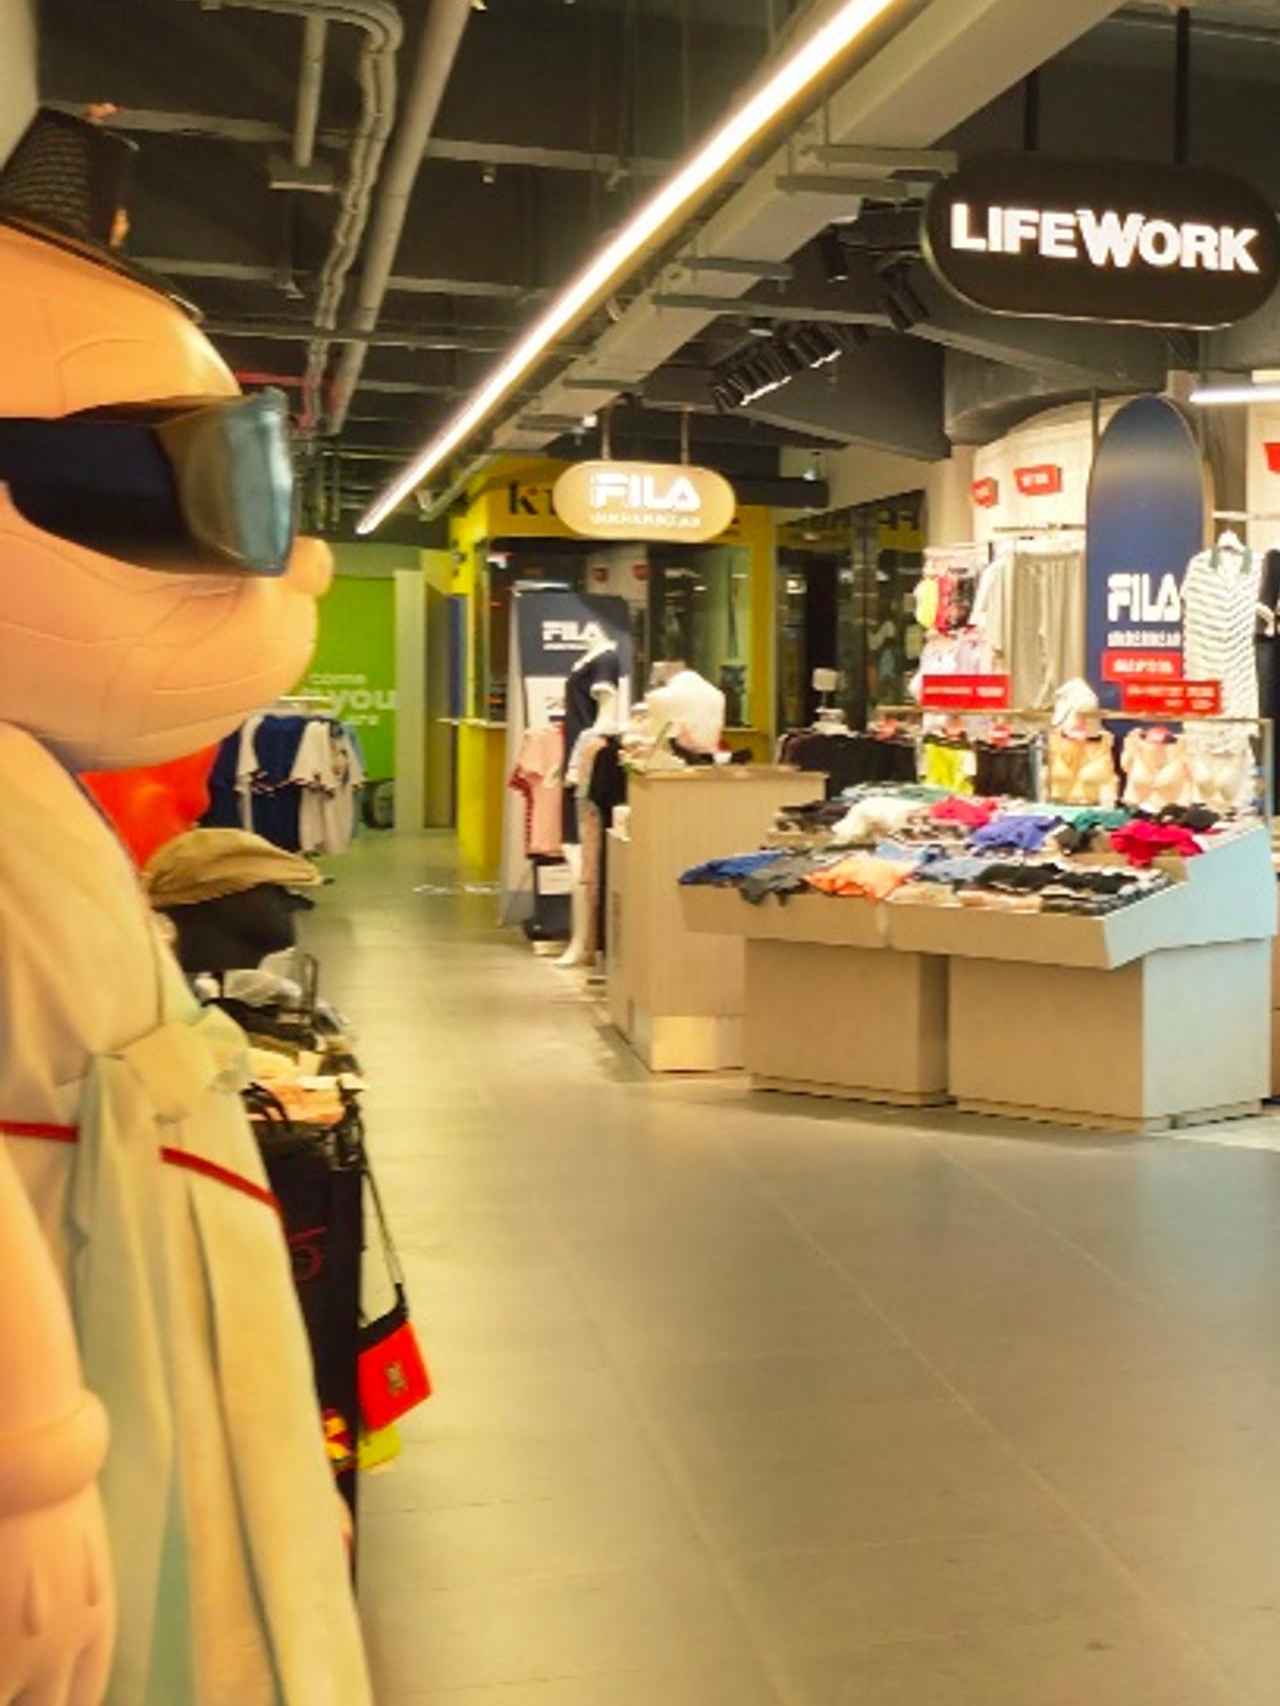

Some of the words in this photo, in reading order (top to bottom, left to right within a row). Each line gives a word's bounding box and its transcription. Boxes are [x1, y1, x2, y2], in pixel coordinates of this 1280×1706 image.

[951, 203, 1259, 274] LIFEWORK
[590, 472, 700, 512] FILA
[1107, 573, 1181, 622] FILA
